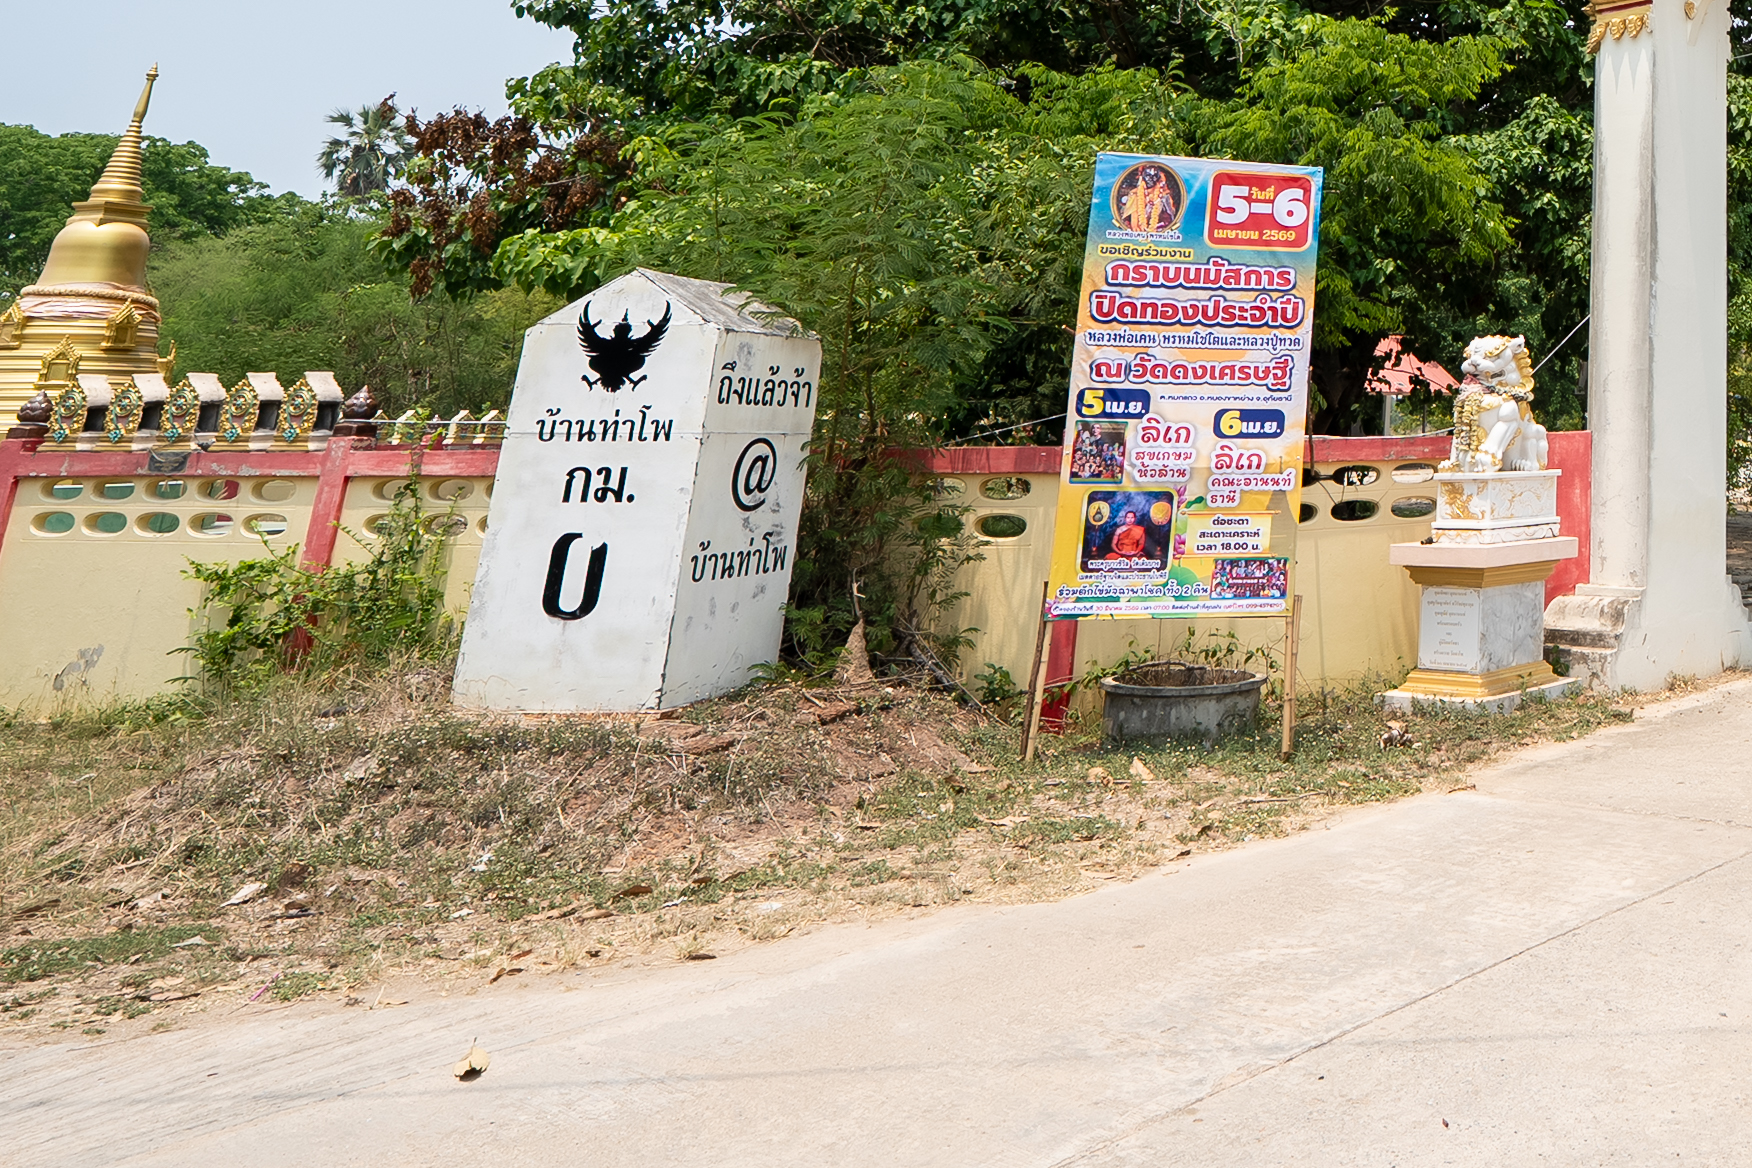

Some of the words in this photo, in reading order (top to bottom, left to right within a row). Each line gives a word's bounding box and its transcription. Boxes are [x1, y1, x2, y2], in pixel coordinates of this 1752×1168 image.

[1251, 185, 1275, 200] วันที่
[1216, 184, 1308, 228] 5-6
[1213, 228, 1259, 240] เมษายน
[1262, 229, 1297, 241] 2569
[1100, 245, 1192, 259] ขอเชิญร่วมงาน
[1109, 260, 1292, 289] กราบนมัสการ
[1094, 294, 1300, 325] ปิดทองประจำปี
[1087, 329, 1157, 345] หลวงพ่อเคน
[717, 360, 812, 409] ถึงแล้วจ้า
[1094, 361, 1123, 379] ณ
[1132, 356, 1291, 388] วัดดงเศรษฐี
[536, 405, 674, 443] บ้านท่าโพ
[1140, 417, 1191, 444] ลิเก
[1214, 444, 1262, 470] ลิเก
[562, 465, 636, 504] กม.
[731, 437, 778, 512] @
[1211, 472, 1292, 487] คณะอานนท์
[1199, 528, 1261, 538] สะเดาะเคราะห์
[1212, 516, 1249, 525] ต่อชะตา
[690, 531, 788, 583] บ้านท่าโพ
[1220, 542, 1248, 550] 18.00
[1165, 581, 1180, 596] ทั้ง
[1183, 586, 1190, 595] 2
[1193, 584, 1209, 595] คืน
